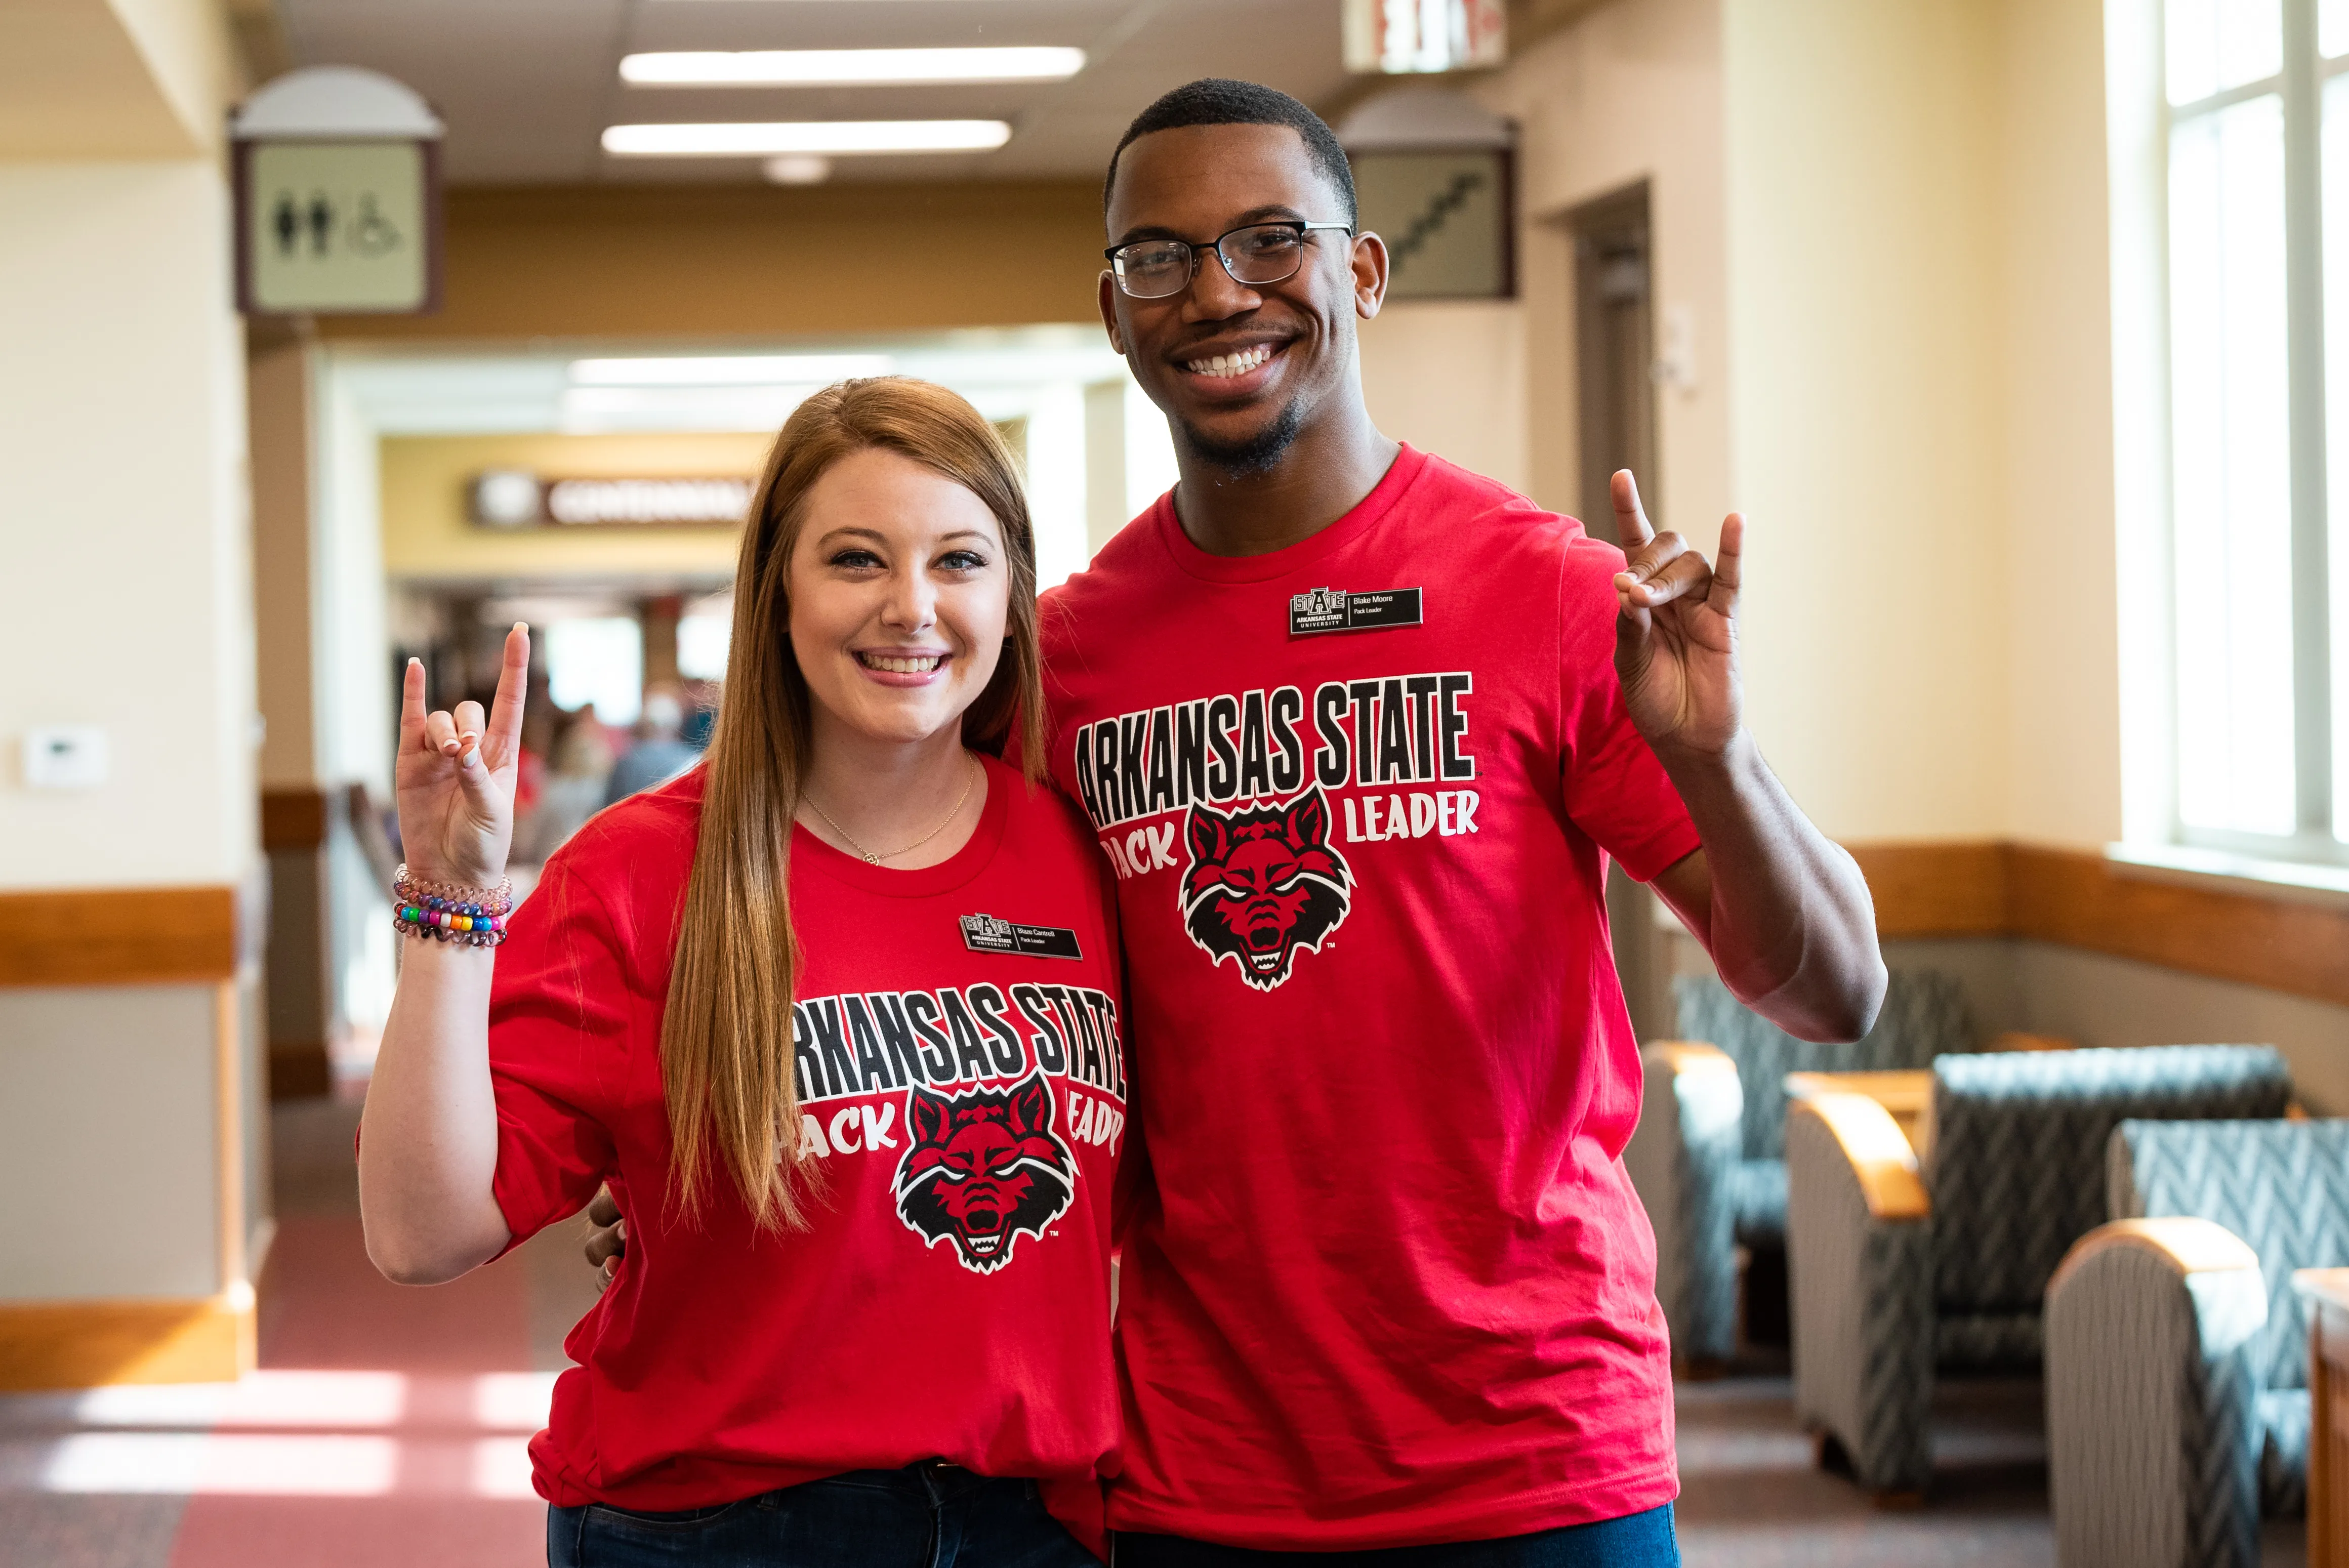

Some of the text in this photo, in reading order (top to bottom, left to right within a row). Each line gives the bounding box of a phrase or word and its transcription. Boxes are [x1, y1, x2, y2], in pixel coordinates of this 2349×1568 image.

[1294, 588, 1344, 615] STATE
[1075, 672, 1476, 833] ARKANSAS STATE
[1344, 791, 1480, 843] LEADER
[1033, 929, 1055, 937] Cantrell
[793, 982, 1025, 1107] RKANSAS
